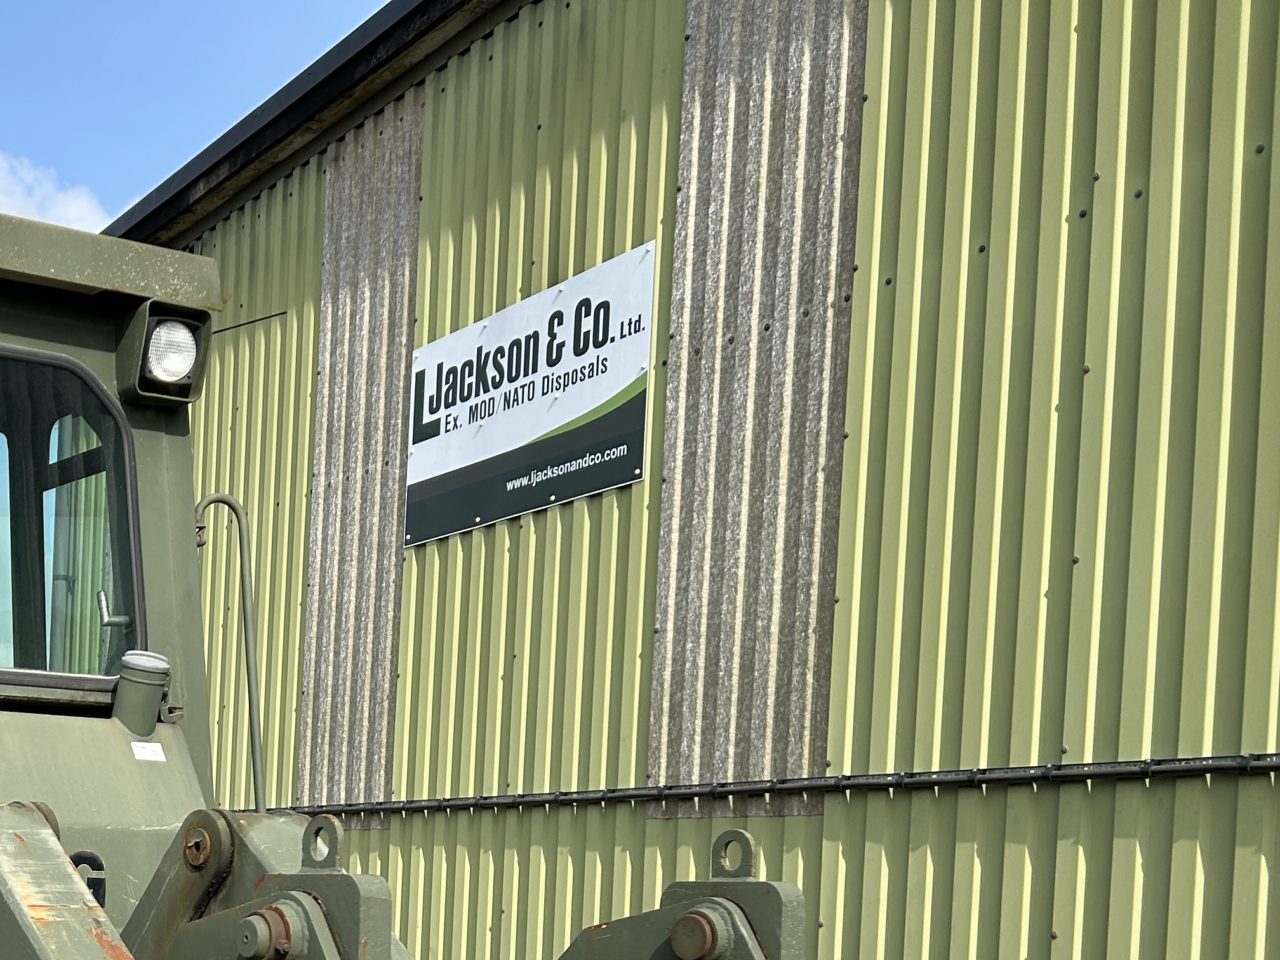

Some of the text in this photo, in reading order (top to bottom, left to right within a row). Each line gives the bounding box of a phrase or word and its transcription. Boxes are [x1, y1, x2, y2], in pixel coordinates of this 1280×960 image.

[545, 310, 566, 367] &
[573, 297, 616, 357] Co.
[619, 314, 646, 339] Ltd.
[444, 354, 609, 434] Ex. MOD/NATO Disposals
[506, 444, 628, 491] www.ljacksonandco.com
